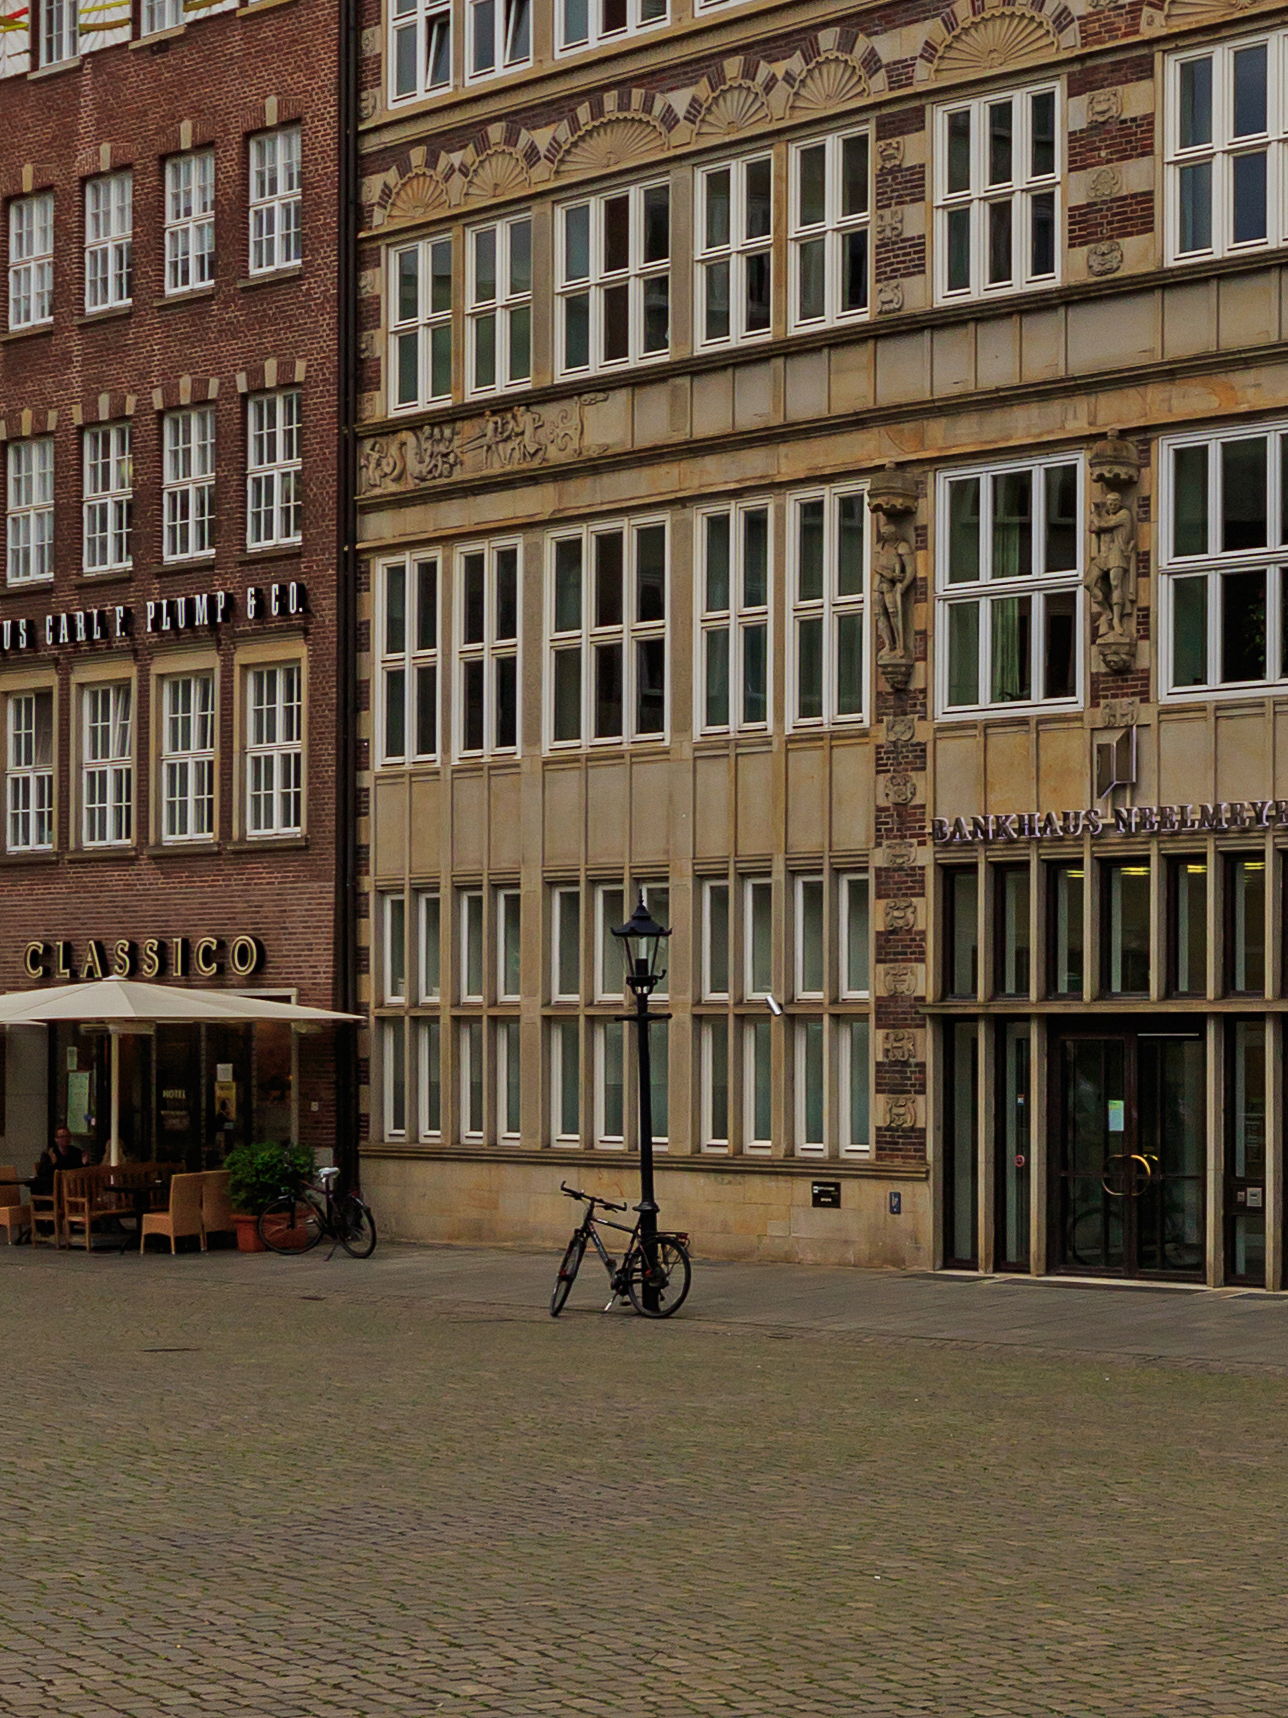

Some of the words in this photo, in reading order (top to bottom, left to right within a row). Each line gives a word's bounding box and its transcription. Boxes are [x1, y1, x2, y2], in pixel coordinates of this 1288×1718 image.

[45, 608, 101, 646] CARL
[115, 605, 126, 637] F.
[146, 590, 226, 633] PLUMP
[246, 586, 257, 620] &
[271, 581, 304, 617] CO.
[931, 808, 1103, 843] BANKHAUS
[23, 935, 258, 980] CLASSICO
